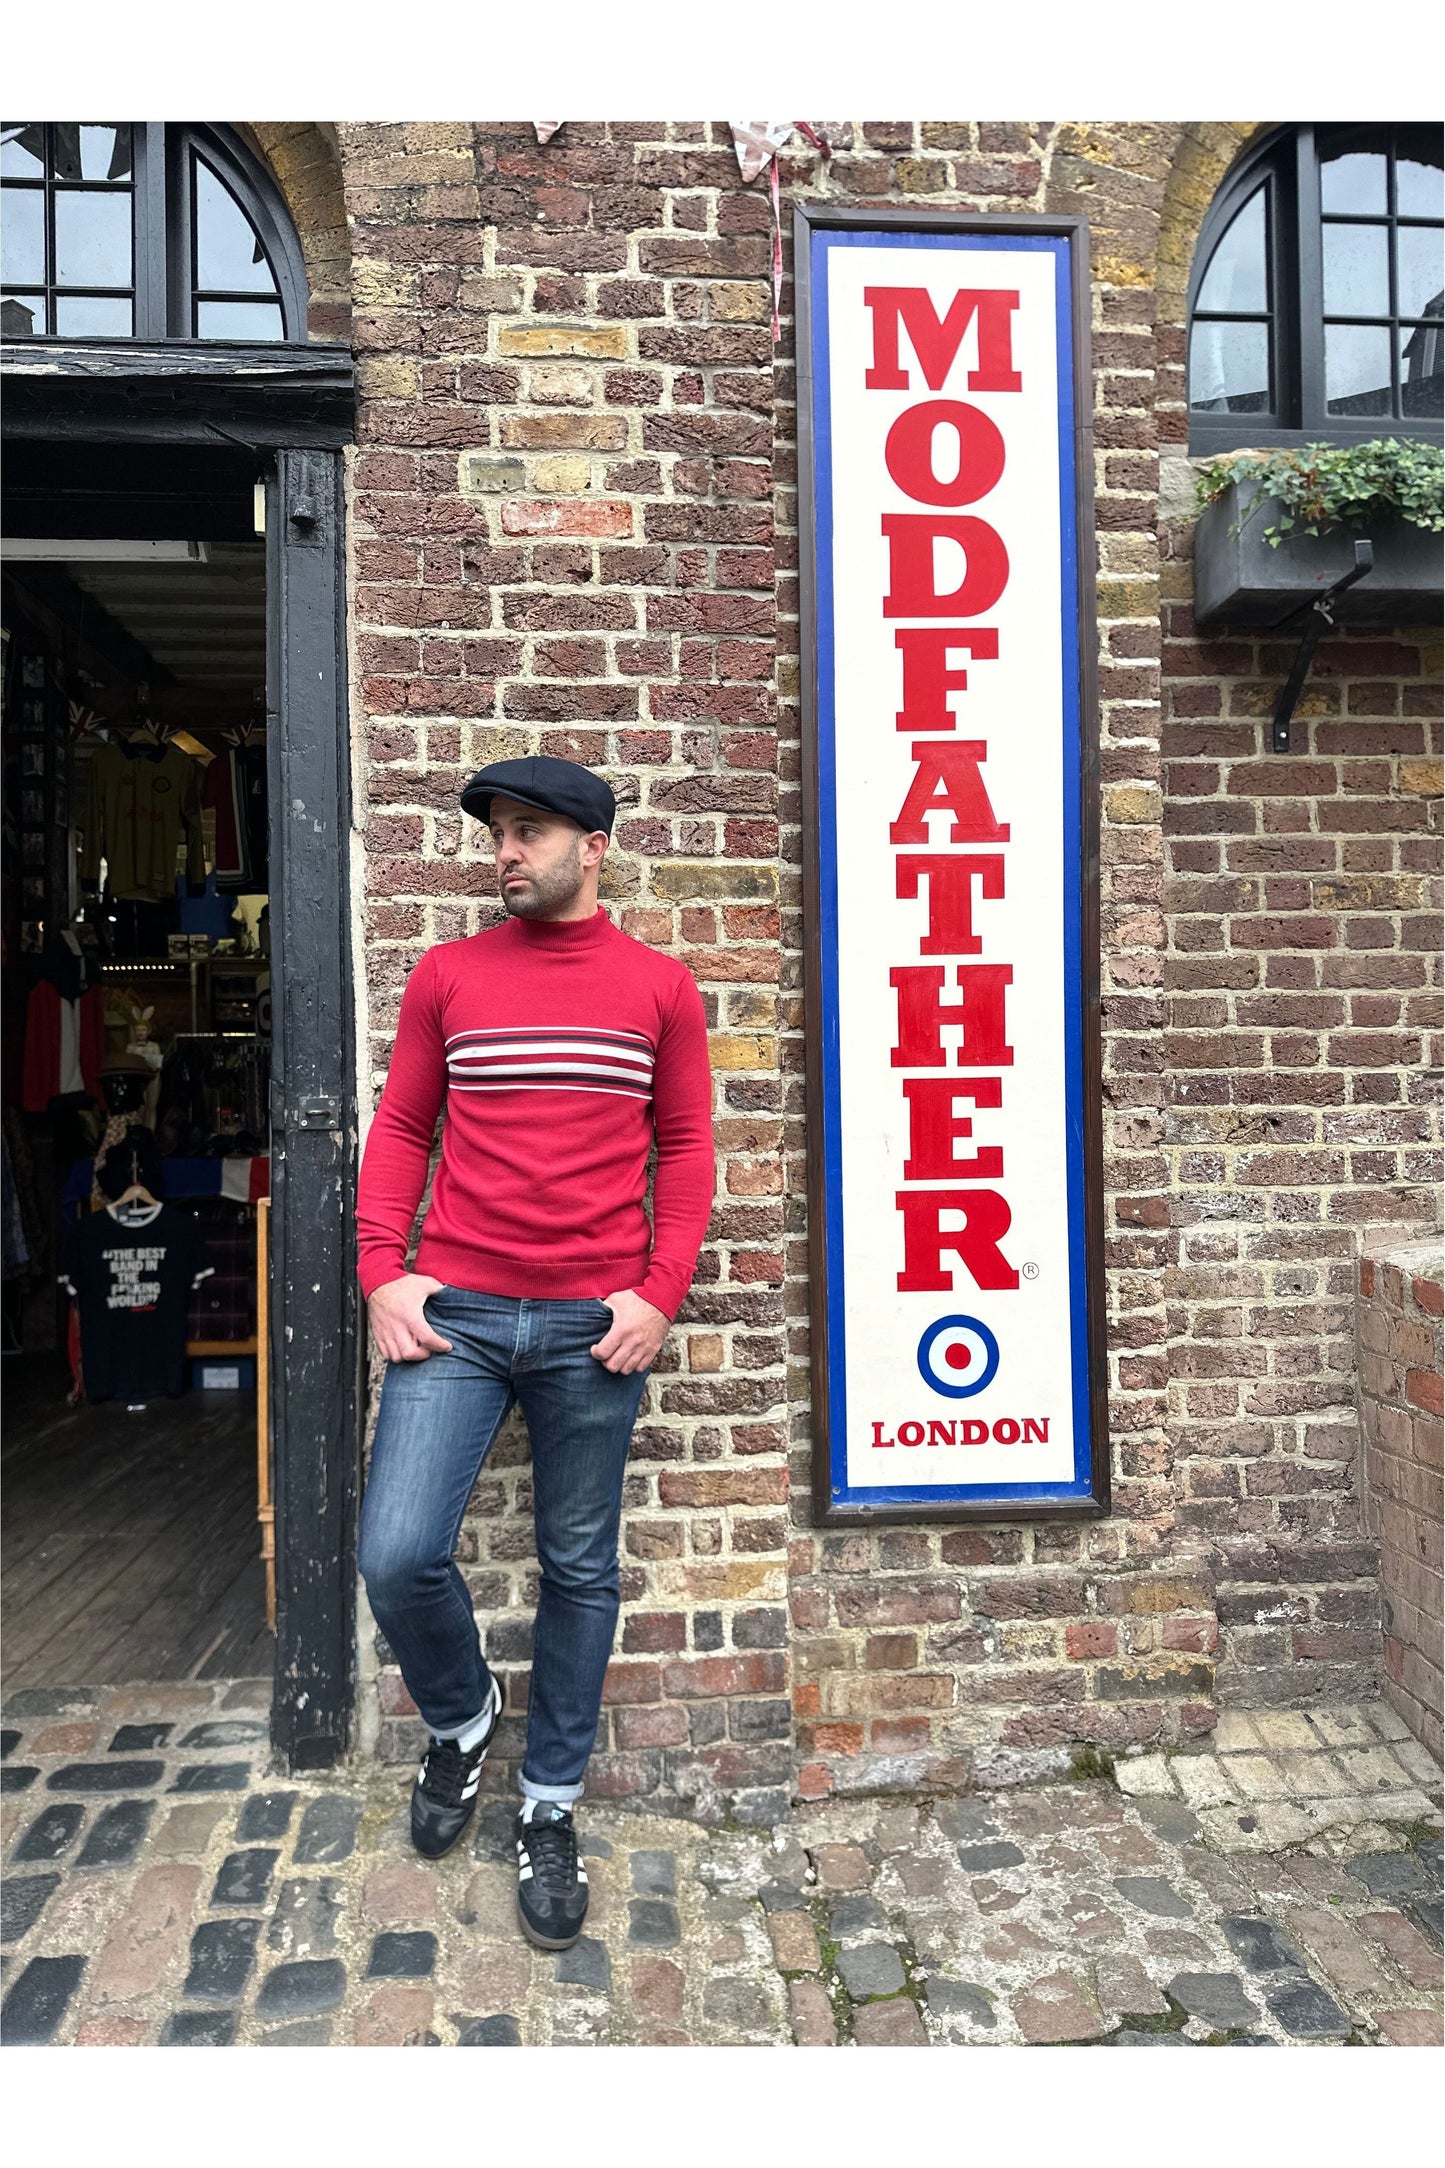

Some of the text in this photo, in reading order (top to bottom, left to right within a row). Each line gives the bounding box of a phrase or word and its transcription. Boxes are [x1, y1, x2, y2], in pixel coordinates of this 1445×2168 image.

[864, 286, 1022, 1292] MODFATHER
[136, 1247, 167, 1260] BEST
[110, 1260, 158, 1273] BAND IN
[118, 1272, 140, 1284] THE
[871, 1417, 1050, 1448] LONDON
